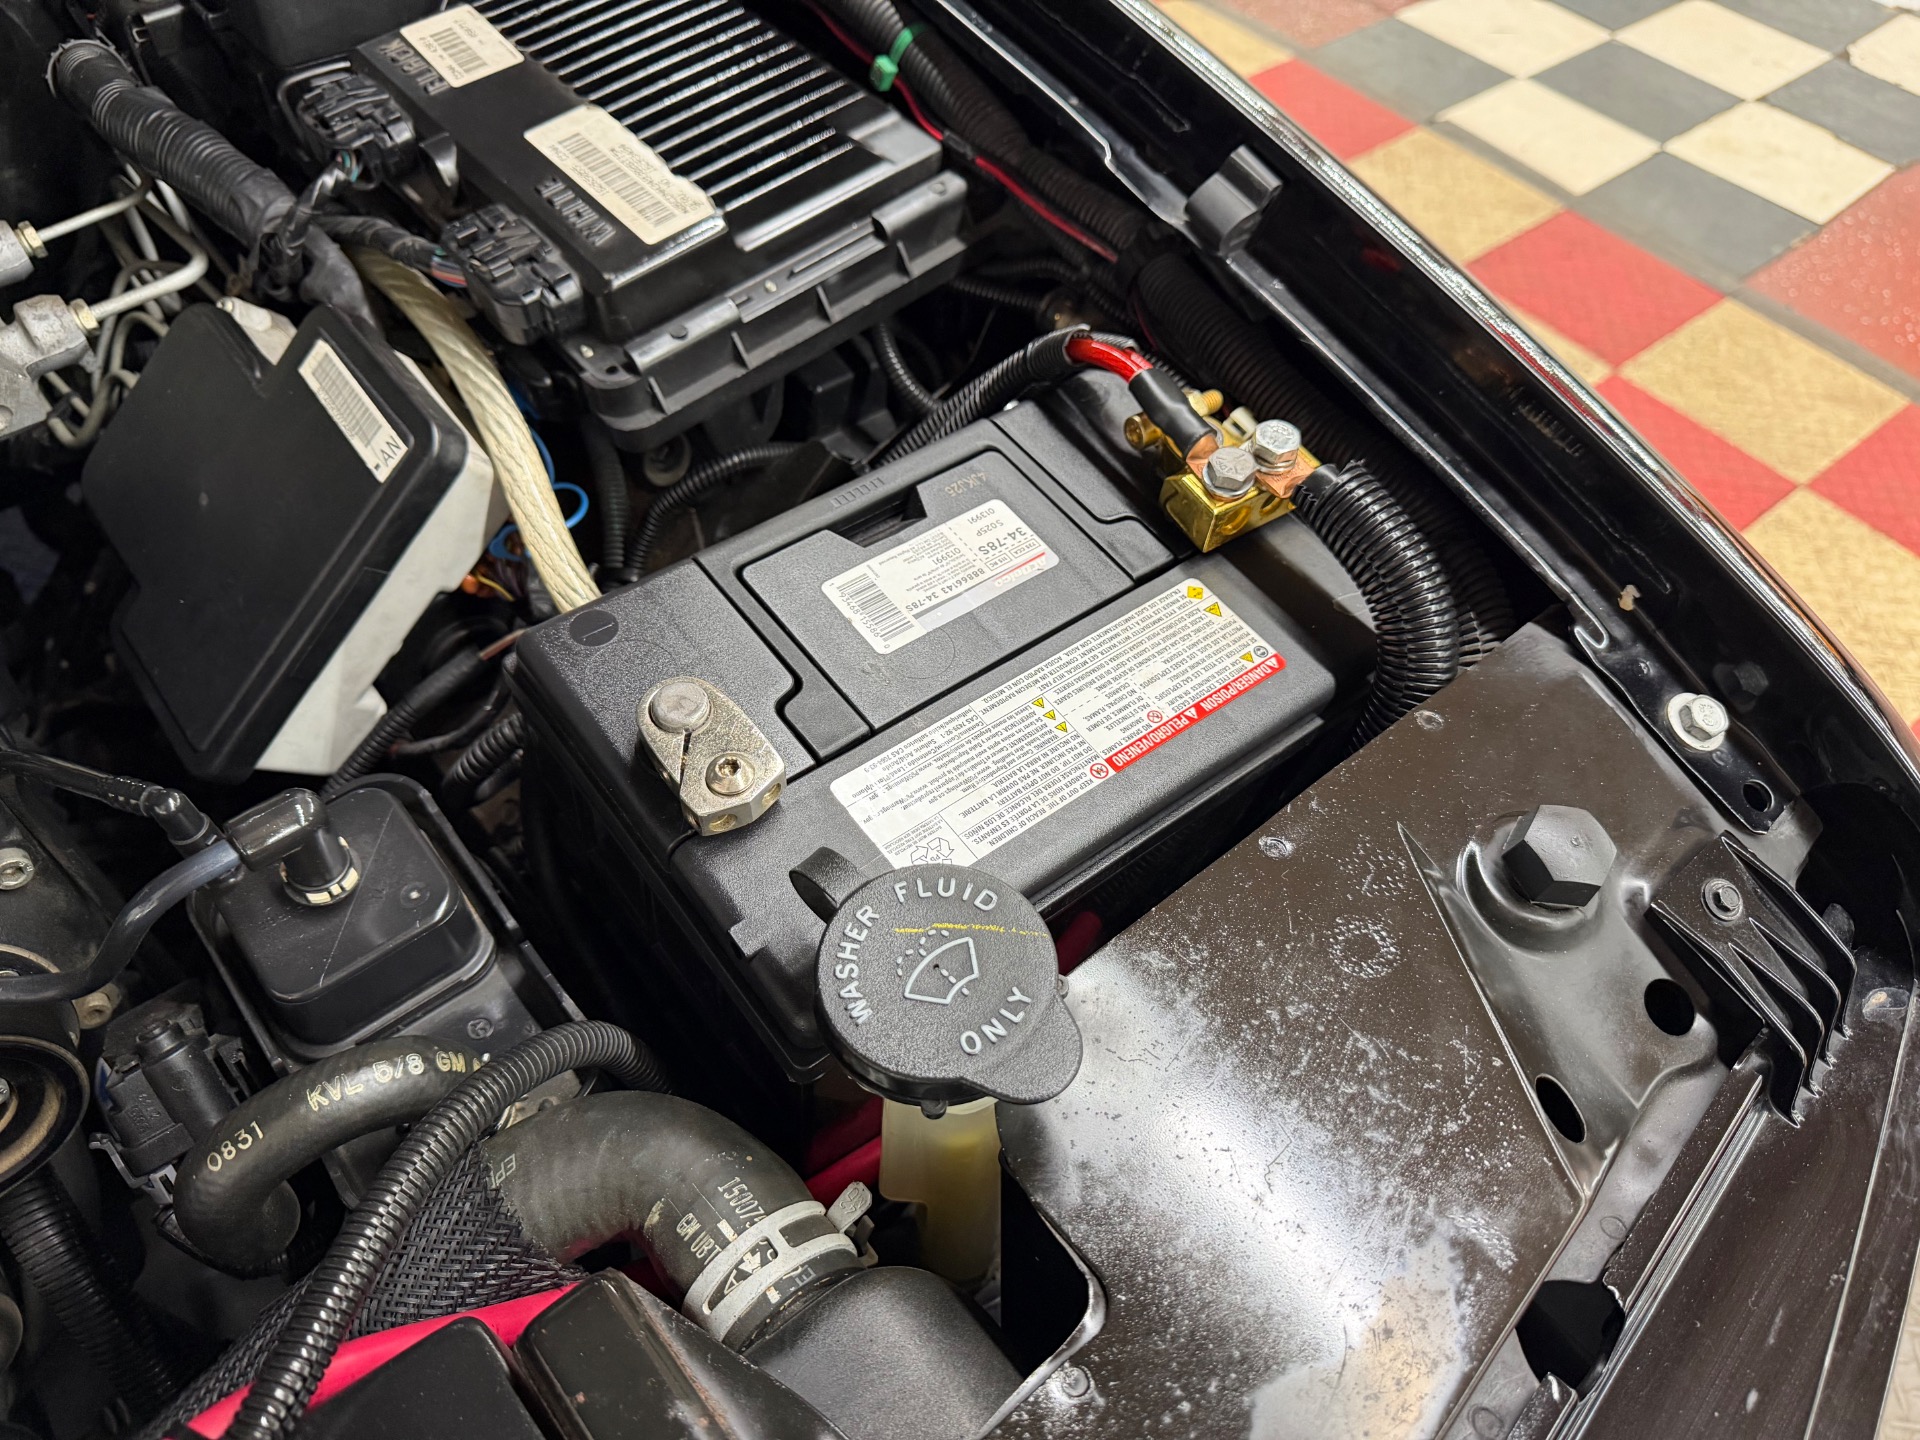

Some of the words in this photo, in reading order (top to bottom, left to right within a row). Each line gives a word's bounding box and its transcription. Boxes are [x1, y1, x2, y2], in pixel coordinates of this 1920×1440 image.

[966, 506, 996, 525] 013991
[973, 518, 1004, 537] S025P
[976, 525, 1027, 556] 34-78S
[930, 546, 962, 565] 013991
[1012, 546, 1026, 556] CCA
[939, 567, 986, 594] 88866143
[903, 590, 939, 612] 34-78S
[1228, 657, 1242, 668] CAN
[1213, 664, 1231, 677] CAUSE
[1226, 663, 1248, 678] SHIELD
[1188, 673, 1217, 692] BLINDNESS
[1198, 662, 1273, 712] DANGER/POISON
[1103, 681, 1131, 699] CIGARROS
[1124, 687, 1137, 697] NO
[1181, 688, 1191, 697] OR
[1187, 681, 1217, 703] EXPLOSIVE
[1133, 694, 1144, 703] DE
[1136, 700, 1152, 713] PAS
[1169, 698, 1191, 713] GASES
[1101, 713, 1112, 722] DE
[1084, 717, 1105, 732] FUMER
[1118, 715, 1145, 734] SMOKING
[1140, 721, 1153, 731] NO
[1068, 731, 1081, 742] NO
[1074, 738, 1087, 748] NE
[1109, 713, 1190, 767] PELIGRO/VENENO
[1046, 737, 1072, 755] INCLINE
[1063, 743, 1078, 755] PAS
[1081, 744, 1093, 754] DO
[1023, 754, 1043, 769] ABRA
[1038, 750, 1050, 760] NI
[1069, 750, 1084, 762] NOT
[1015, 764, 1027, 774] LA
[1027, 766, 1040, 776] NE
[1048, 764, 1061, 774] DO
[1016, 771, 1031, 783] PAS
[1036, 770, 1051, 782] NOT
[1062, 770, 1089, 790] GARDER
[994, 778, 1020, 797] OUVRIR
[1019, 777, 1039, 792] OPEN
[1040, 775, 1063, 792] FUERA
[1076, 777, 1094, 791] KEEP
[986, 791, 998, 802] LA
[1029, 787, 1044, 799] DEL
[1046, 784, 1066, 800] HORS
[1055, 793, 1068, 803] OF
[1065, 786, 1080, 798] OUT
[1002, 793, 1033, 816] ALCANCE
[1029, 799, 1042, 810] LA
[1037, 794, 1050, 805] DE
[1044, 798, 1060, 810] THE
[993, 810, 1006, 821] DE
[1007, 804, 1033, 824] PORTÉE
[1024, 806, 1047, 823] REACH
[981, 815, 998, 828] LOS
[998, 818, 1011, 829] ES
[1015, 818, 1027, 829] OF
[894, 877, 998, 911] FLUID
[834, 904, 880, 1025] WASHER
[960, 986, 1032, 1055] ONLY
[207, 1120, 265, 1171] 0831
[307, 1073, 363, 1112] KVL
[373, 1053, 424, 1084] 5/8
[436, 1050, 466, 1073] GM
